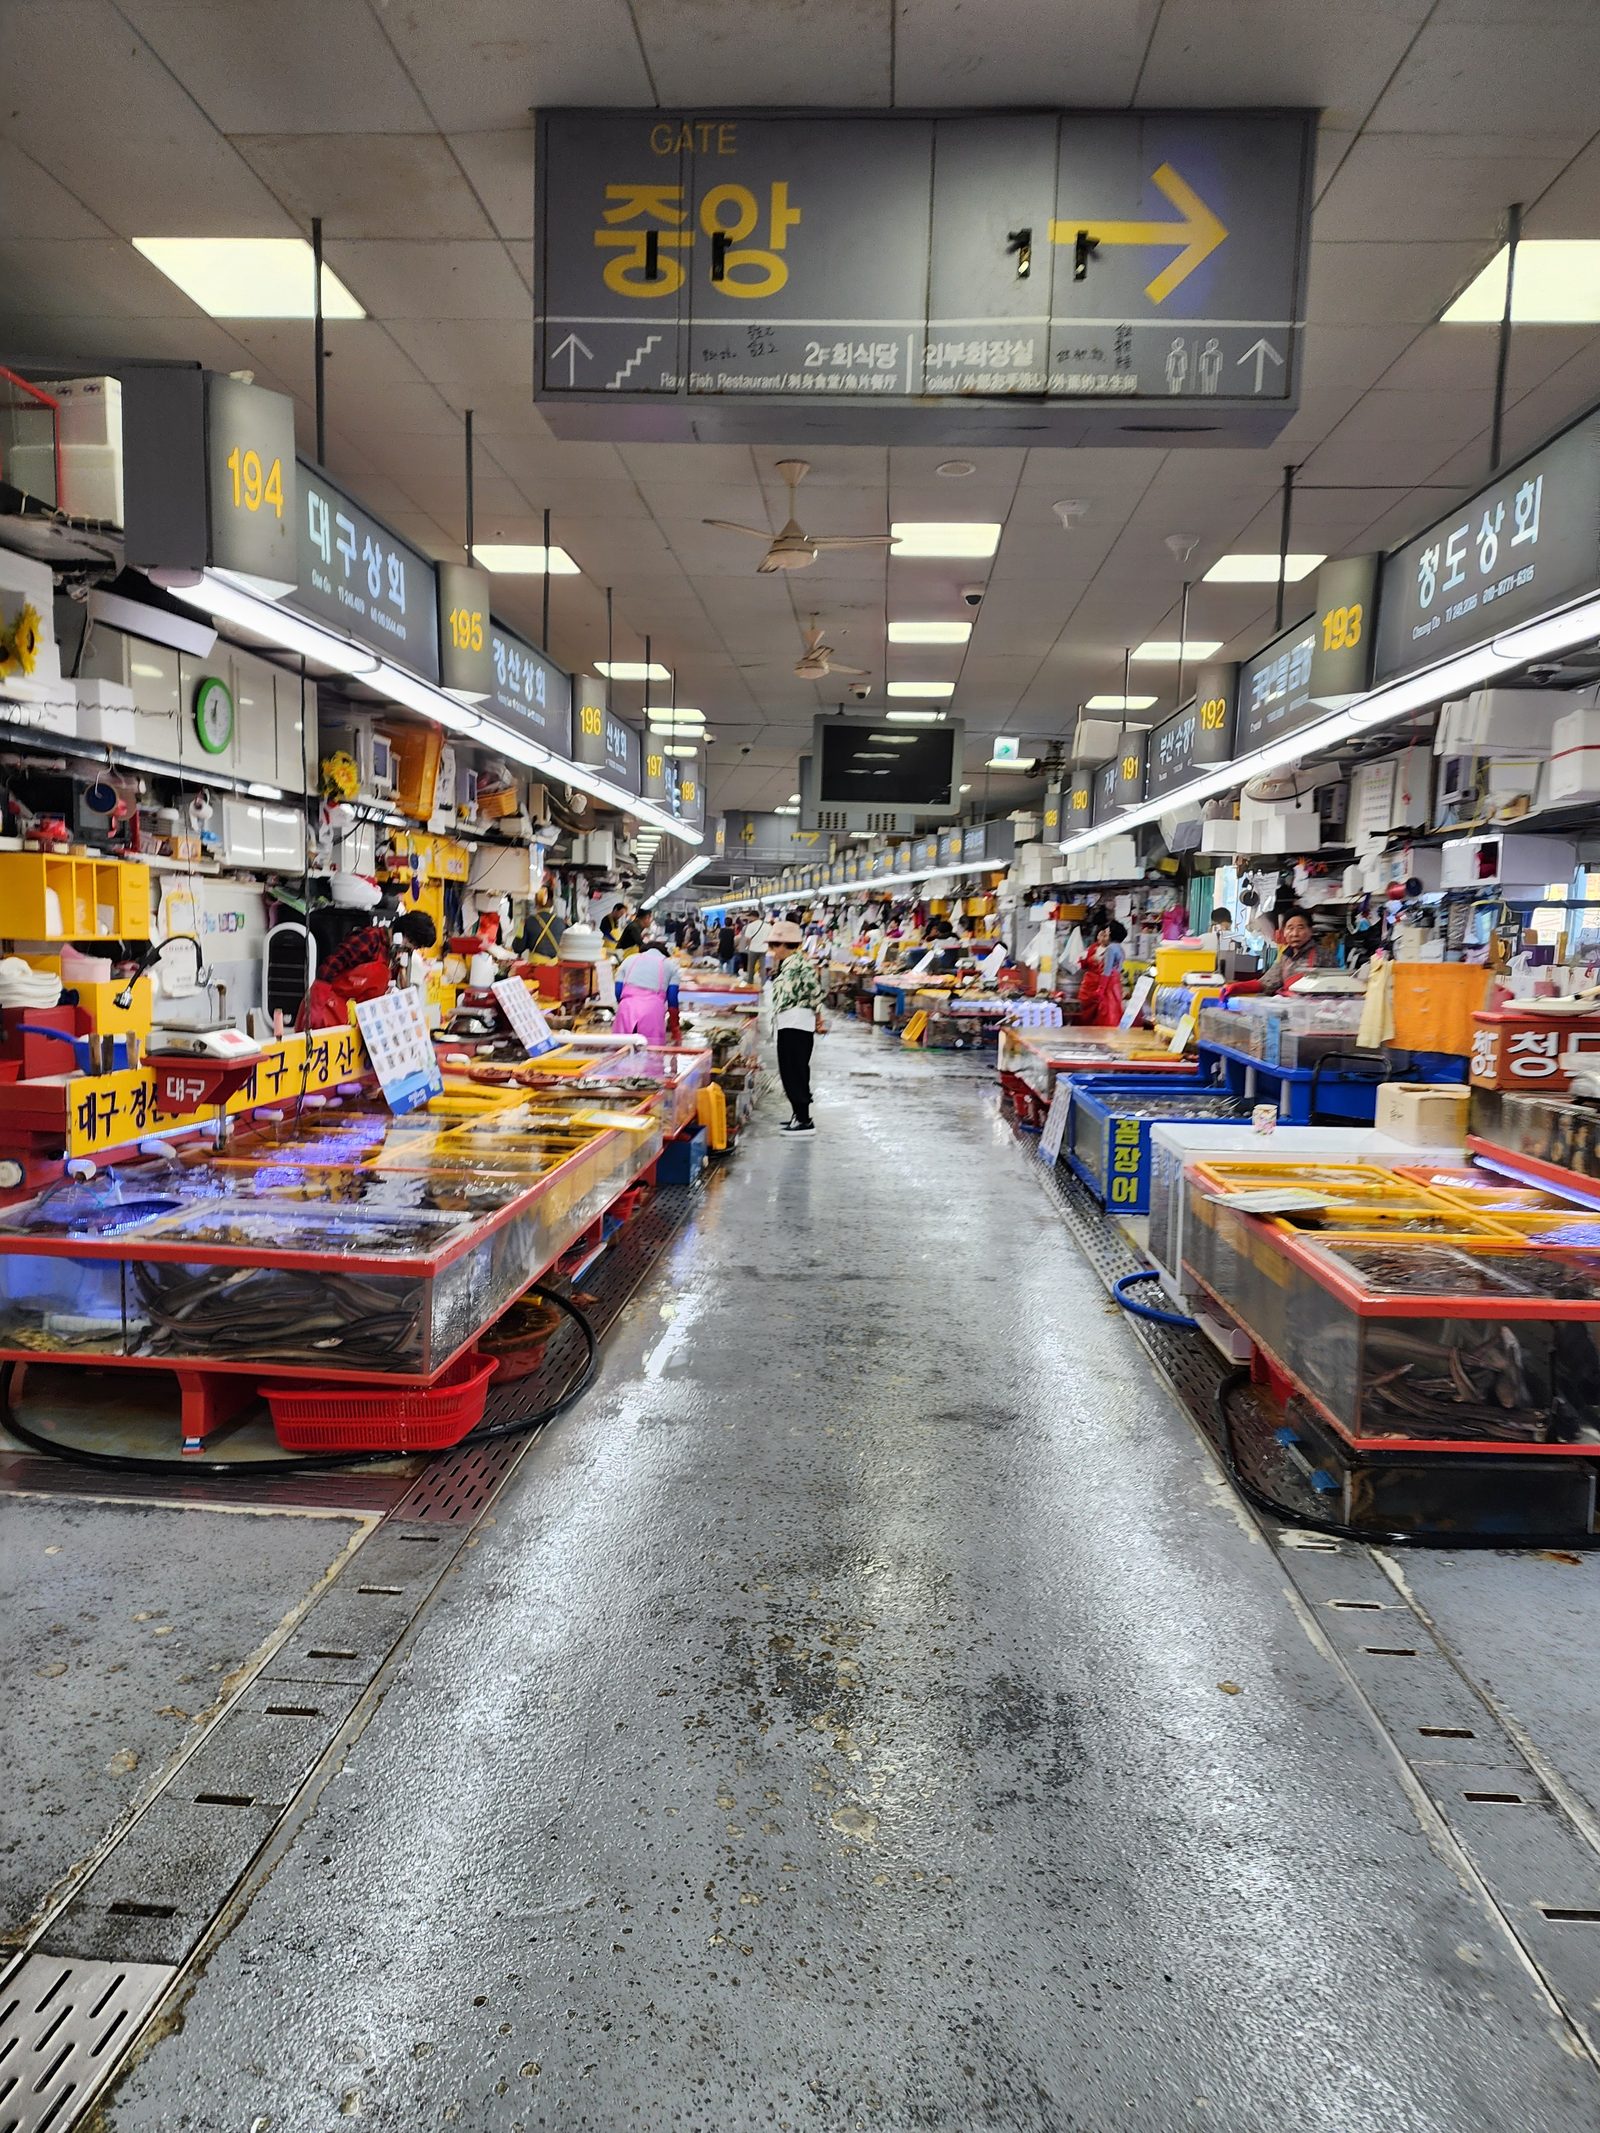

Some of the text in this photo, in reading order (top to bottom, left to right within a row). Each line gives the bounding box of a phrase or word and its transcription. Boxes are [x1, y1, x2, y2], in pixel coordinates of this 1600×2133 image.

[650, 123, 738, 155] GATE
[594, 182, 801, 298] 중앙
[804, 340, 899, 370] 2F회식당
[921, 339, 1034, 368] 외부화장실
[660, 372, 685, 388] Raw
[689, 372, 714, 390] Fish
[227, 446, 284, 519] 194
[308, 489, 406, 614] 대구상회
[1417, 474, 1544, 609] 청도상회
[450, 608, 483, 651] 195
[1322, 602, 1363, 652] 193
[492, 637, 546, 709] 경산상회
[580, 706, 601, 736] 196
[1200, 698, 1226, 730] 192
[646, 754, 663, 777] 197
[1121, 755, 1140, 781] 191
[681, 779, 696, 801] 198
[1071, 789, 1089, 810] 190
[166, 1076, 206, 1103] 대구
[1111, 1119, 1143, 1205] 꼼장어
